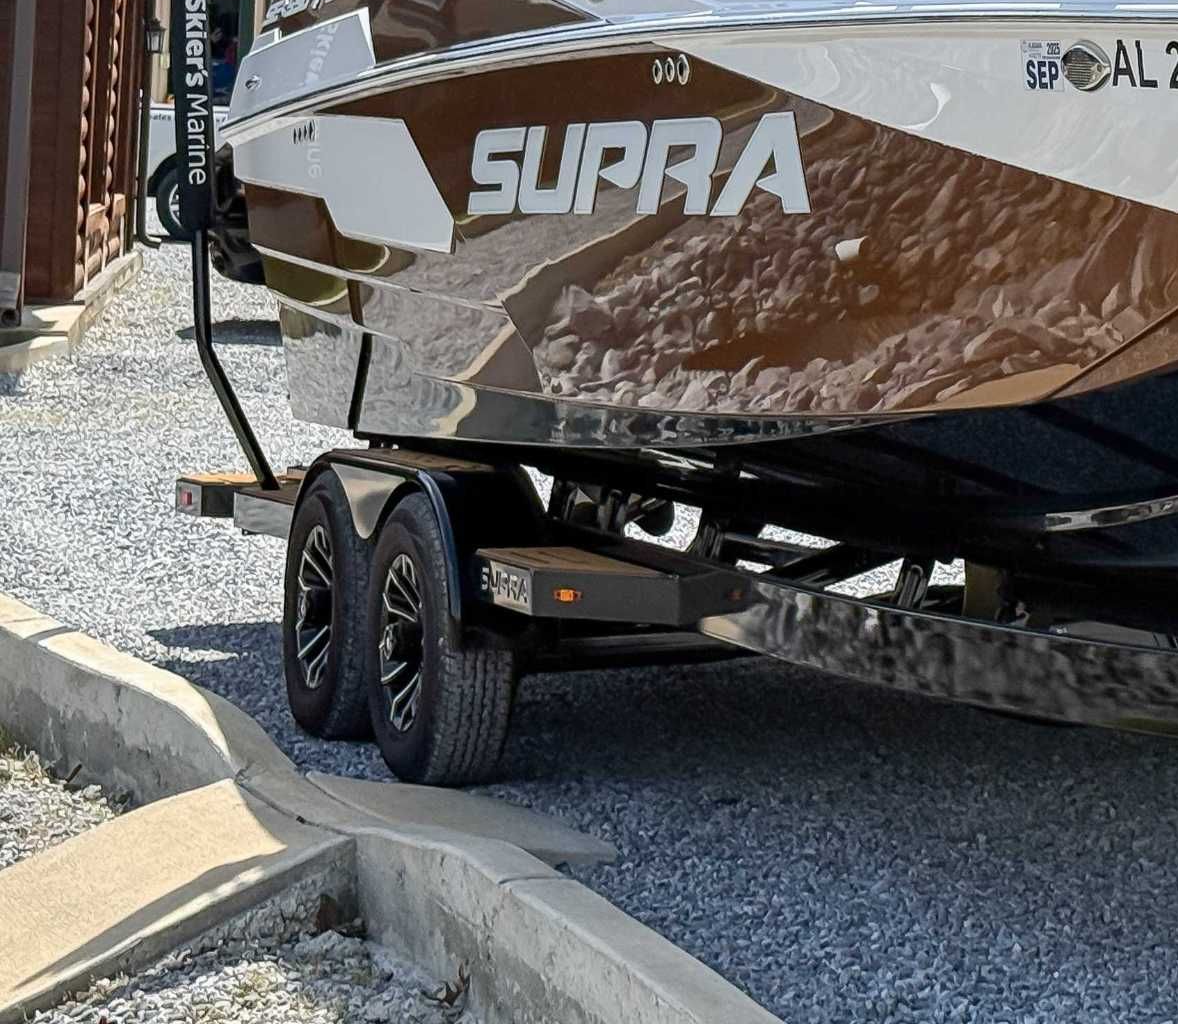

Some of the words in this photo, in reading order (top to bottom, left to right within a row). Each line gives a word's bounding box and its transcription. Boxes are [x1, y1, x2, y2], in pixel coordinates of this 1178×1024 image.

[1026, 59, 1059, 89] SEP
[1112, 39, 1159, 88] AL
[186, 93, 211, 185] Marine
[467, 111, 811, 217] SUPRA
[481, 566, 528, 604] SUPRA
